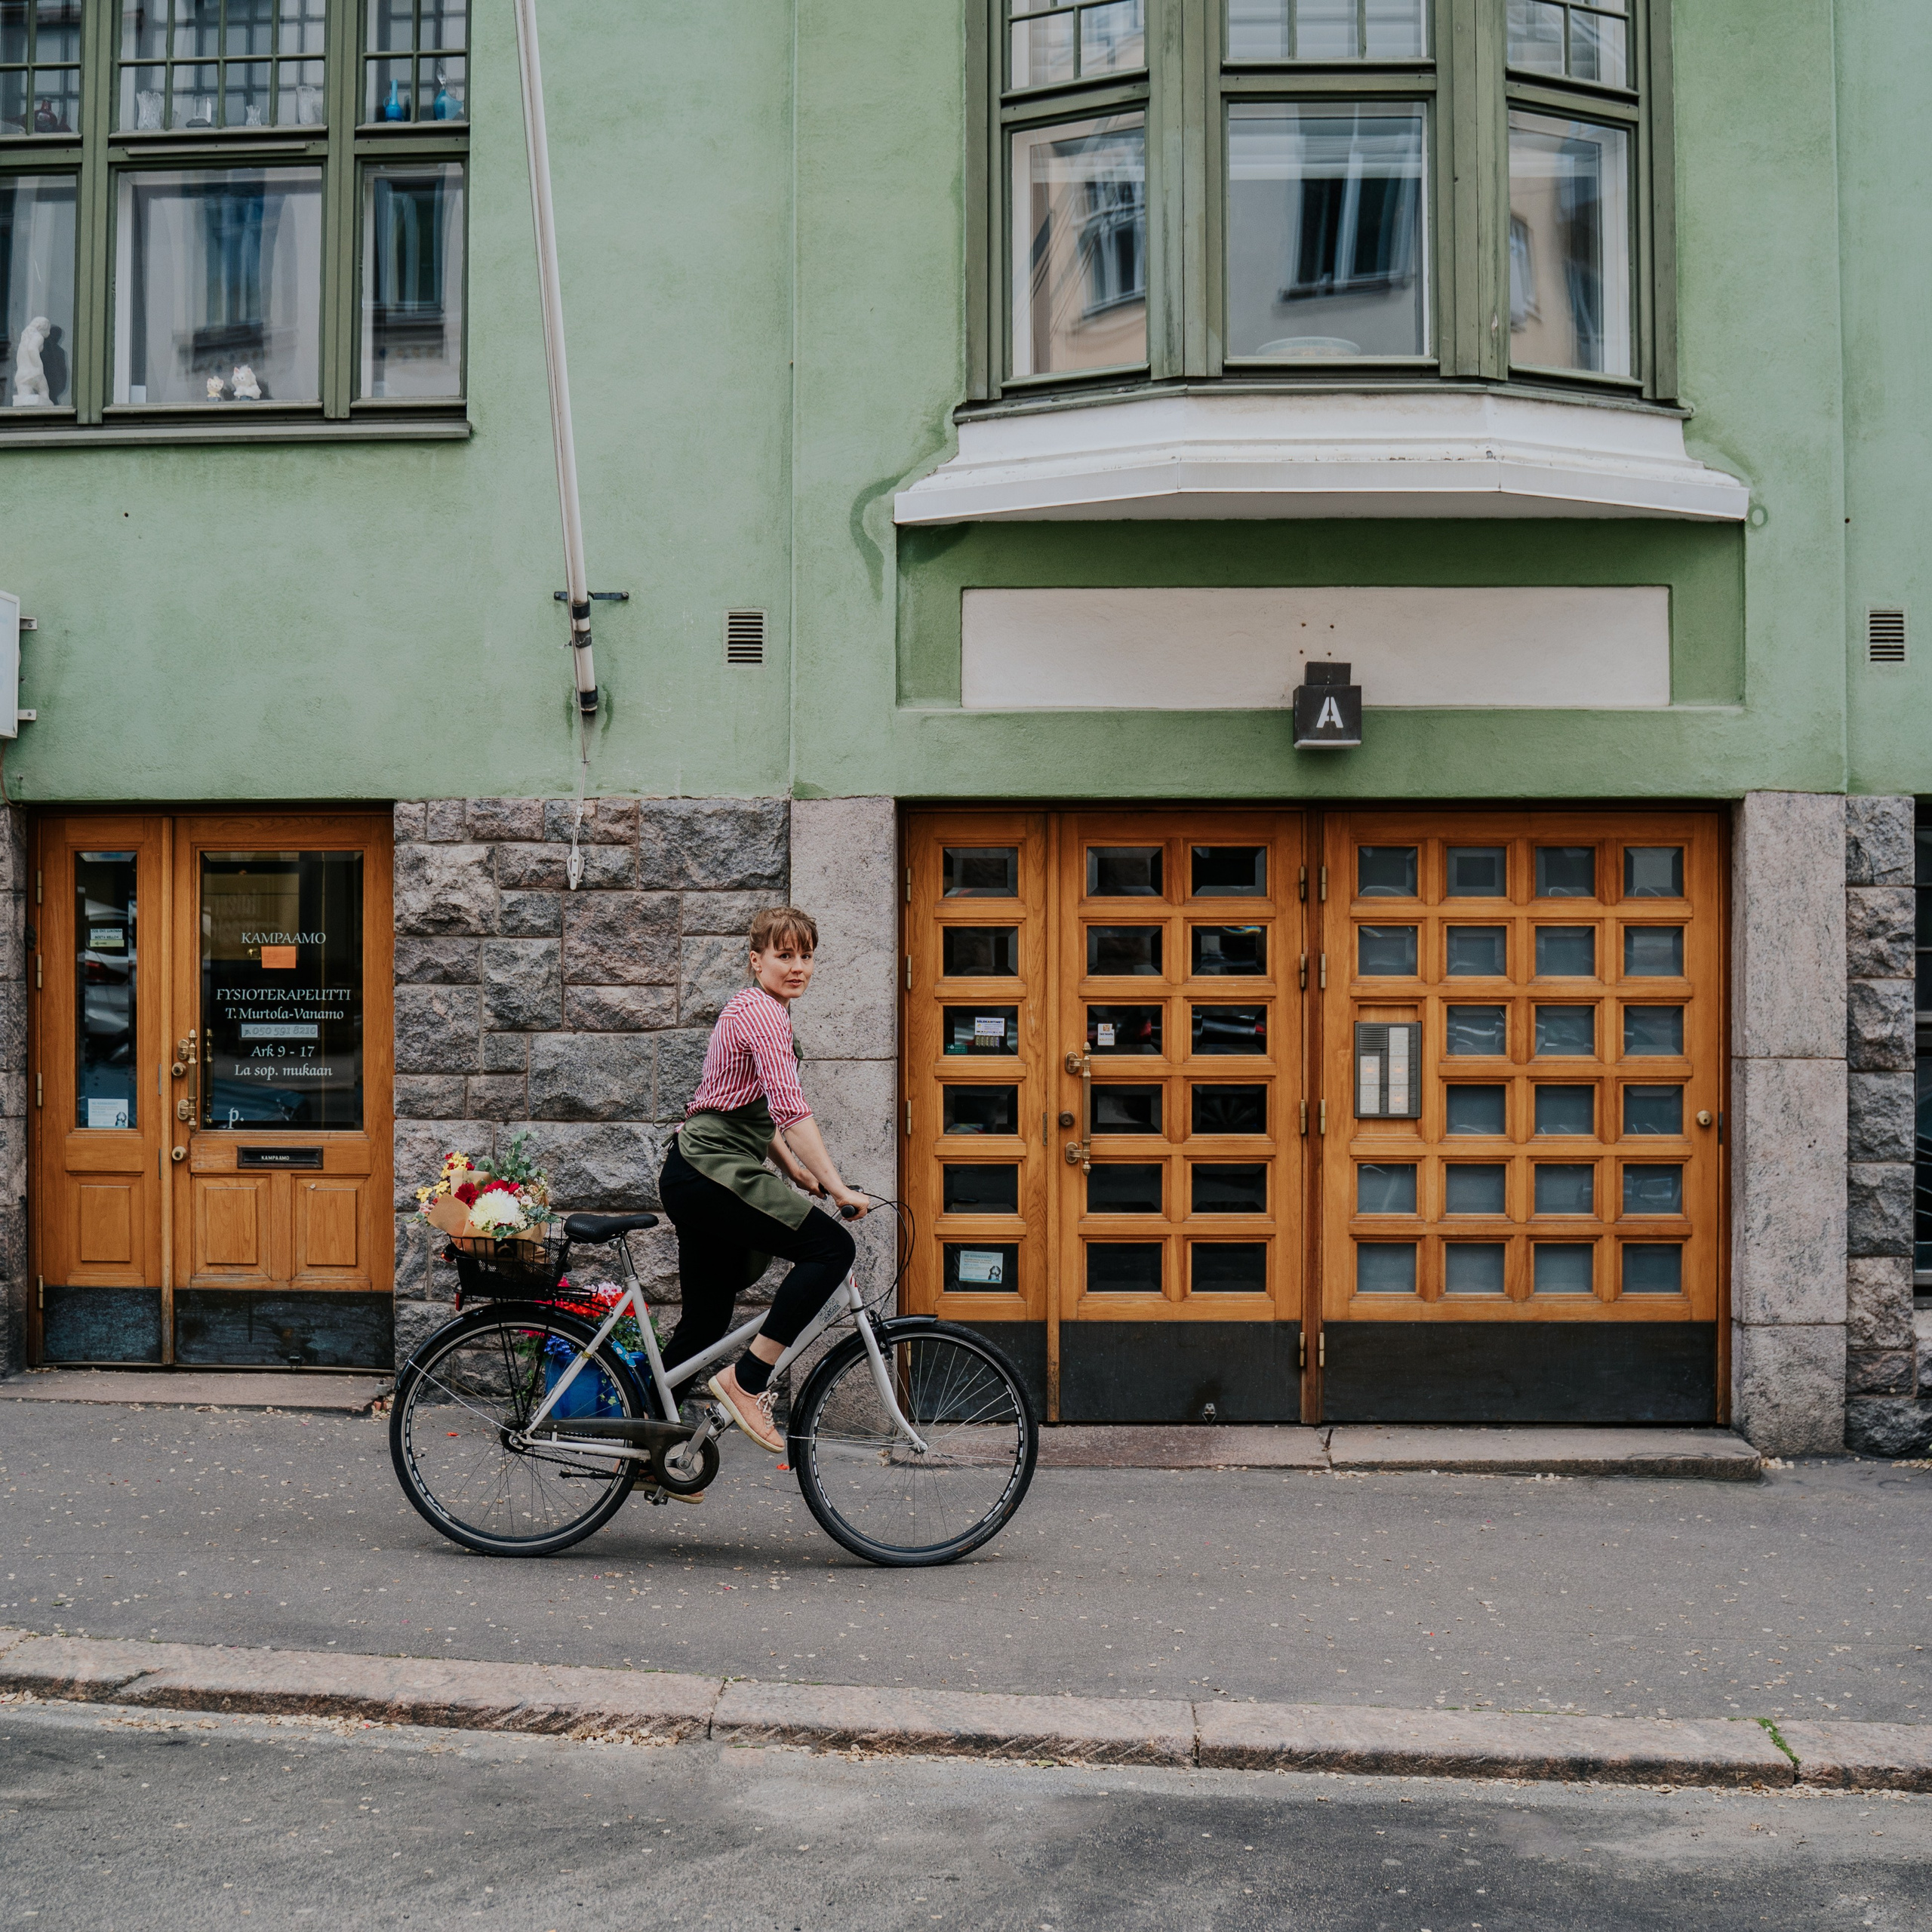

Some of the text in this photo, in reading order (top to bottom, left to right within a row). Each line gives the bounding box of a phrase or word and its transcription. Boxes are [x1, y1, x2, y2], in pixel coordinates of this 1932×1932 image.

[1315, 696, 1344, 728] A
[241, 932, 327, 944] KAMPAAMO
[216, 989, 352, 1001] FYSIOTERAPEUTTI
[252, 1026, 272, 1036] 050
[274, 1026, 291, 1037] 591
[292, 1025, 317, 1035] 8210
[250, 1044, 275, 1057] Ark
[277, 1045, 286, 1057] 9
[300, 1045, 315, 1057] 17
[234, 1063, 333, 1081] La sop. mukaan
[227, 1106, 245, 1130] p.
